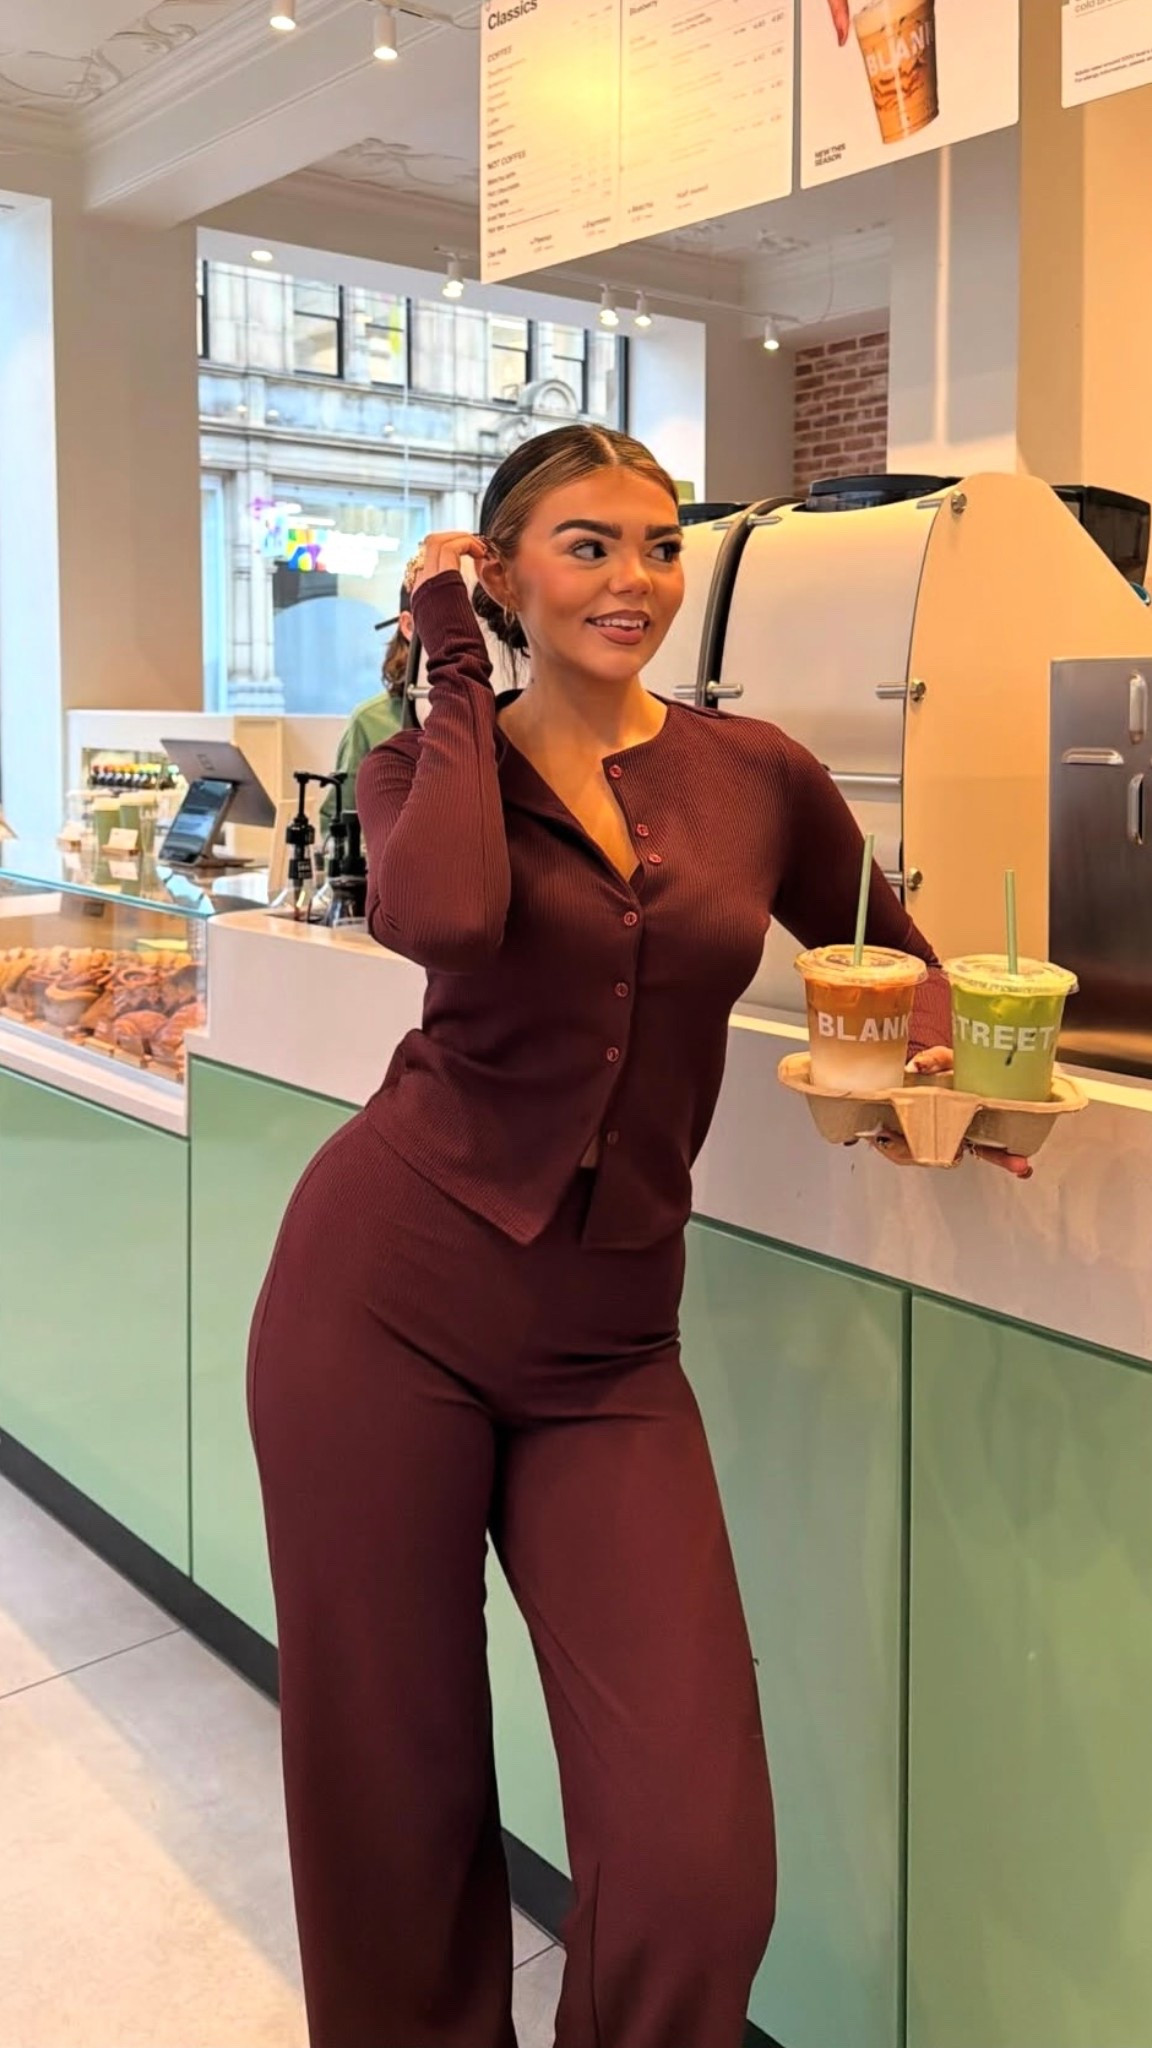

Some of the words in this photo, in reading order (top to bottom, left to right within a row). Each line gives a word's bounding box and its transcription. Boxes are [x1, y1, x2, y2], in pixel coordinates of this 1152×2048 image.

[488, 0, 538, 30] Classics
[487, 158, 500, 169] NOT
[501, 150, 527, 166] COFFEE
[815, 149, 830, 158] NEW
[815, 153, 842, 167] SEASON
[952, 1014, 1056, 1051] TREET
